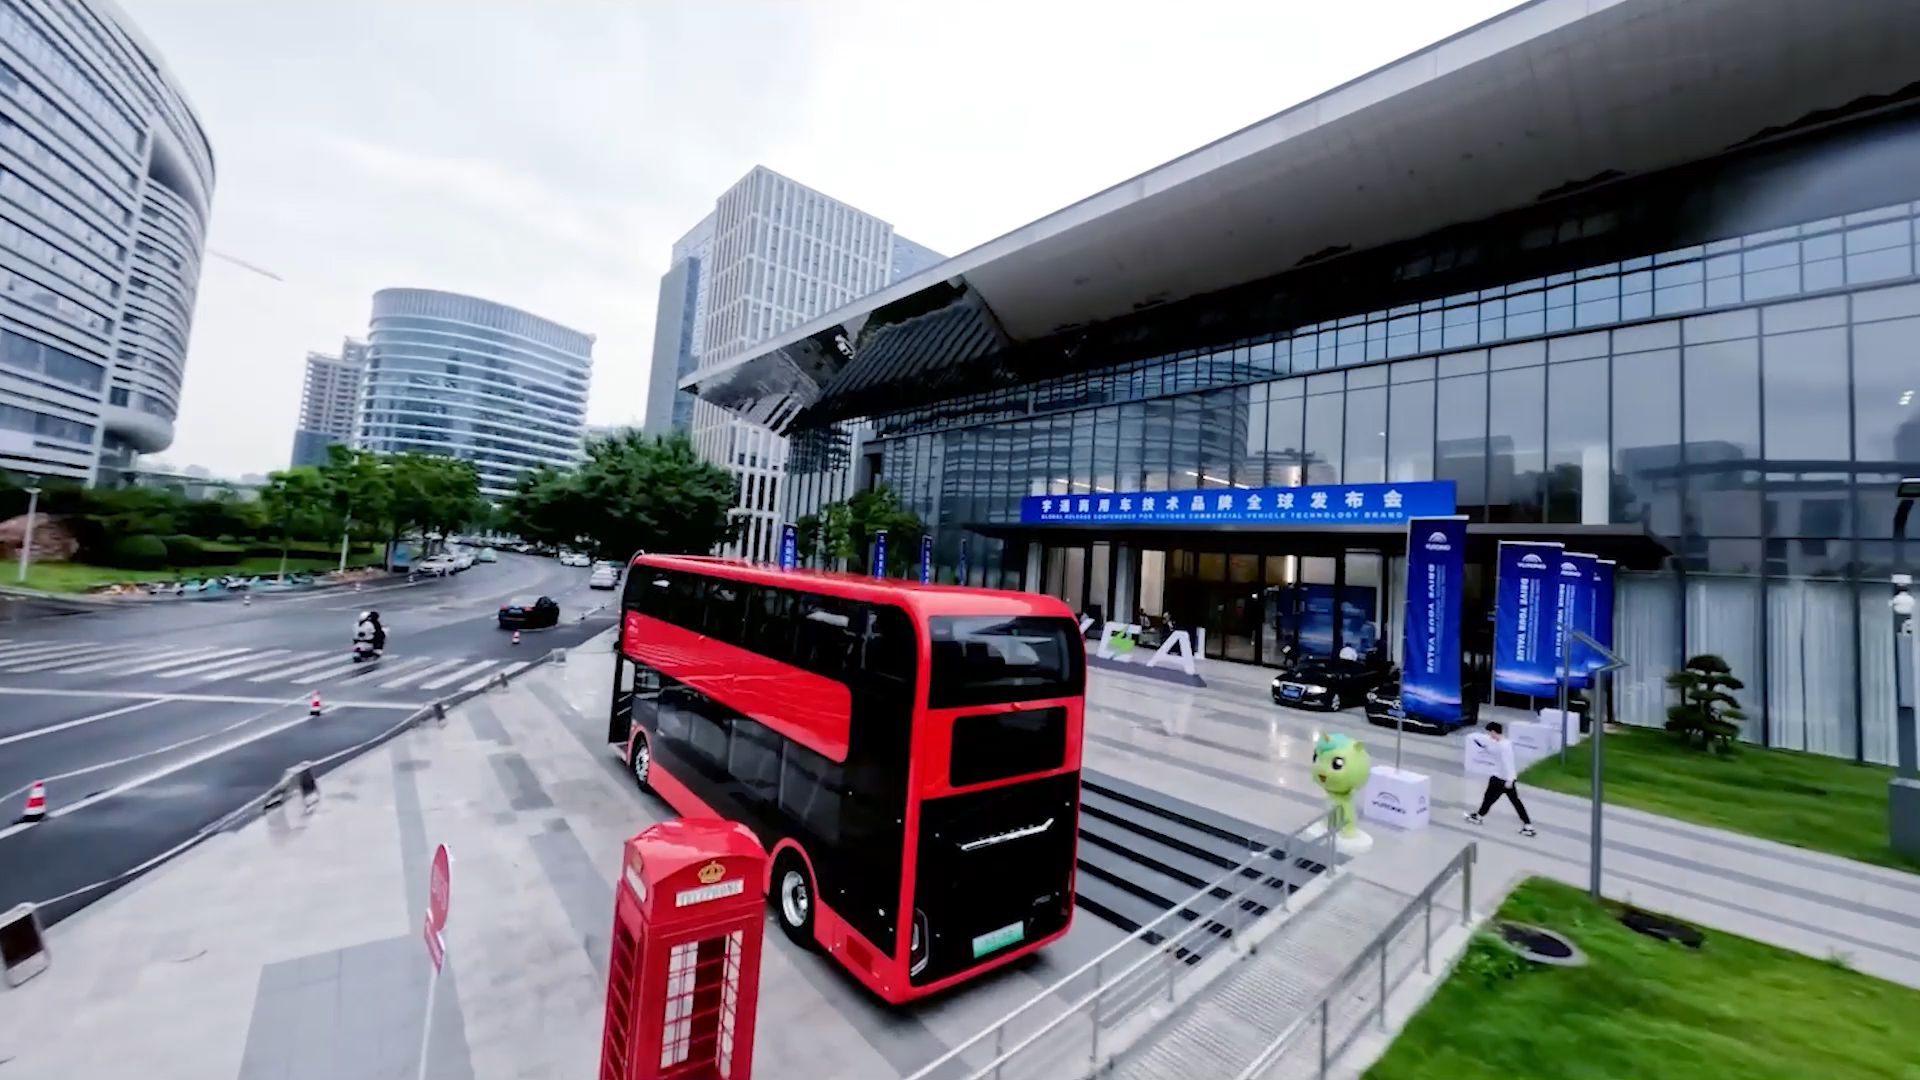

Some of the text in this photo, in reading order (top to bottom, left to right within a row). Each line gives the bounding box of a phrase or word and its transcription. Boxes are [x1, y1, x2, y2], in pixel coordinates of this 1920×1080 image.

[1041, 489, 1403, 513] 宇通商用车技术品牌全球发布会
[1290, 511, 1359, 519] TECHNOLOGY
[1364, 511, 1403, 519] BRAND
[1428, 563, 1436, 599] DRIVE
[1516, 578, 1529, 662] DRIVE YOUR VALUE
[1426, 636, 1436, 674] VALUE
